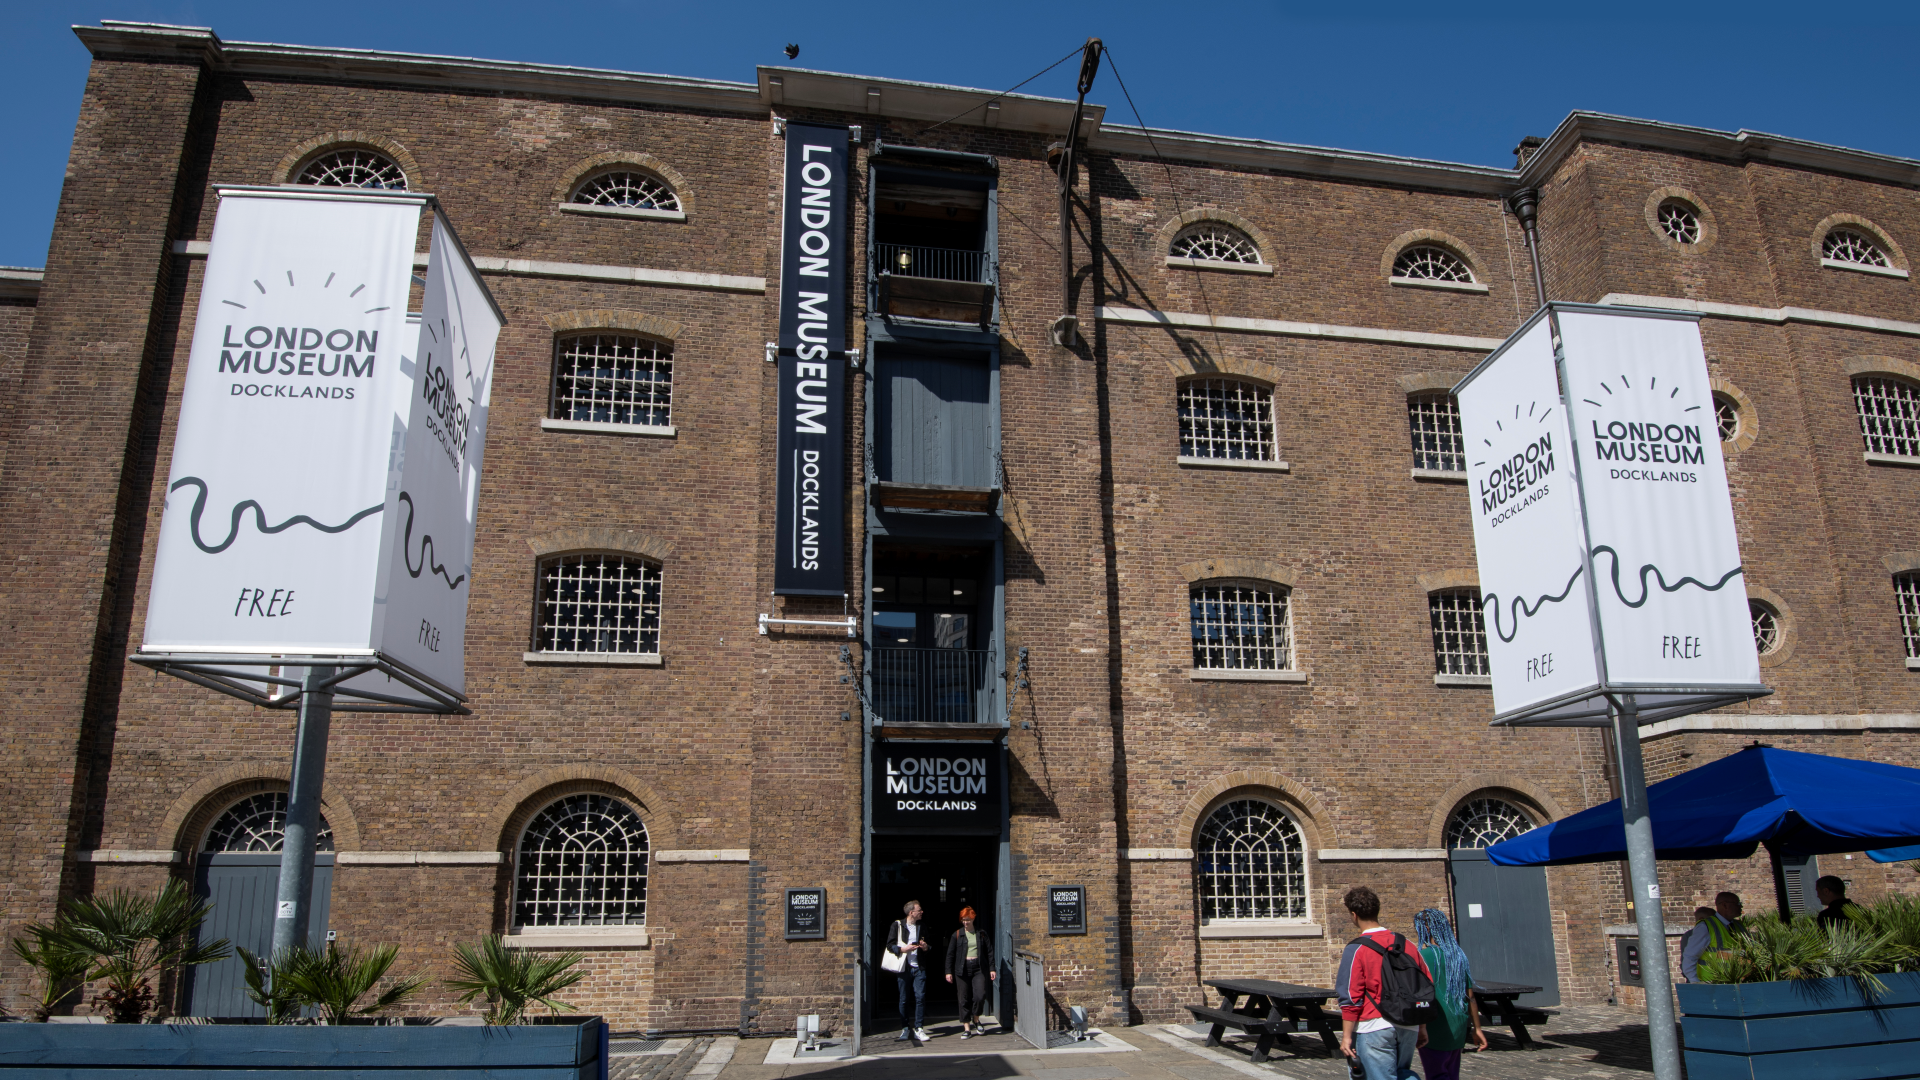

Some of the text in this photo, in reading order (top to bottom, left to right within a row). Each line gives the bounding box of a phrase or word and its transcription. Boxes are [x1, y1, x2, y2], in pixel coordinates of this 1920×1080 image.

[222, 325, 378, 353] LONDON
[218, 350, 375, 378] MUSEUM
[795, 144, 832, 571] LONDON MUSEUM DOCKLANDS
[230, 383, 355, 400] DOCKLANDS
[426, 352, 469, 438] LONDON
[423, 376, 467, 460] MUSEUM
[1592, 419, 1702, 445] LONDON
[426, 415, 460, 473] DOCKLANDS
[1595, 441, 1705, 465] MUSEUM
[1479, 432, 1552, 497] LONDON
[1610, 468, 1697, 483] DOCKLANDS
[1482, 451, 1555, 515] MUSEUM
[1491, 486, 1550, 528] DOCKLANDS
[234, 587, 295, 617] FREE
[418, 618, 441, 653] FREE
[1662, 635, 1702, 659] FREE
[1526, 653, 1554, 682] FREE
[886, 757, 986, 776] LONDON
[886, 776, 987, 794] MUSEUM
[897, 800, 977, 811] DOCKLANDS
